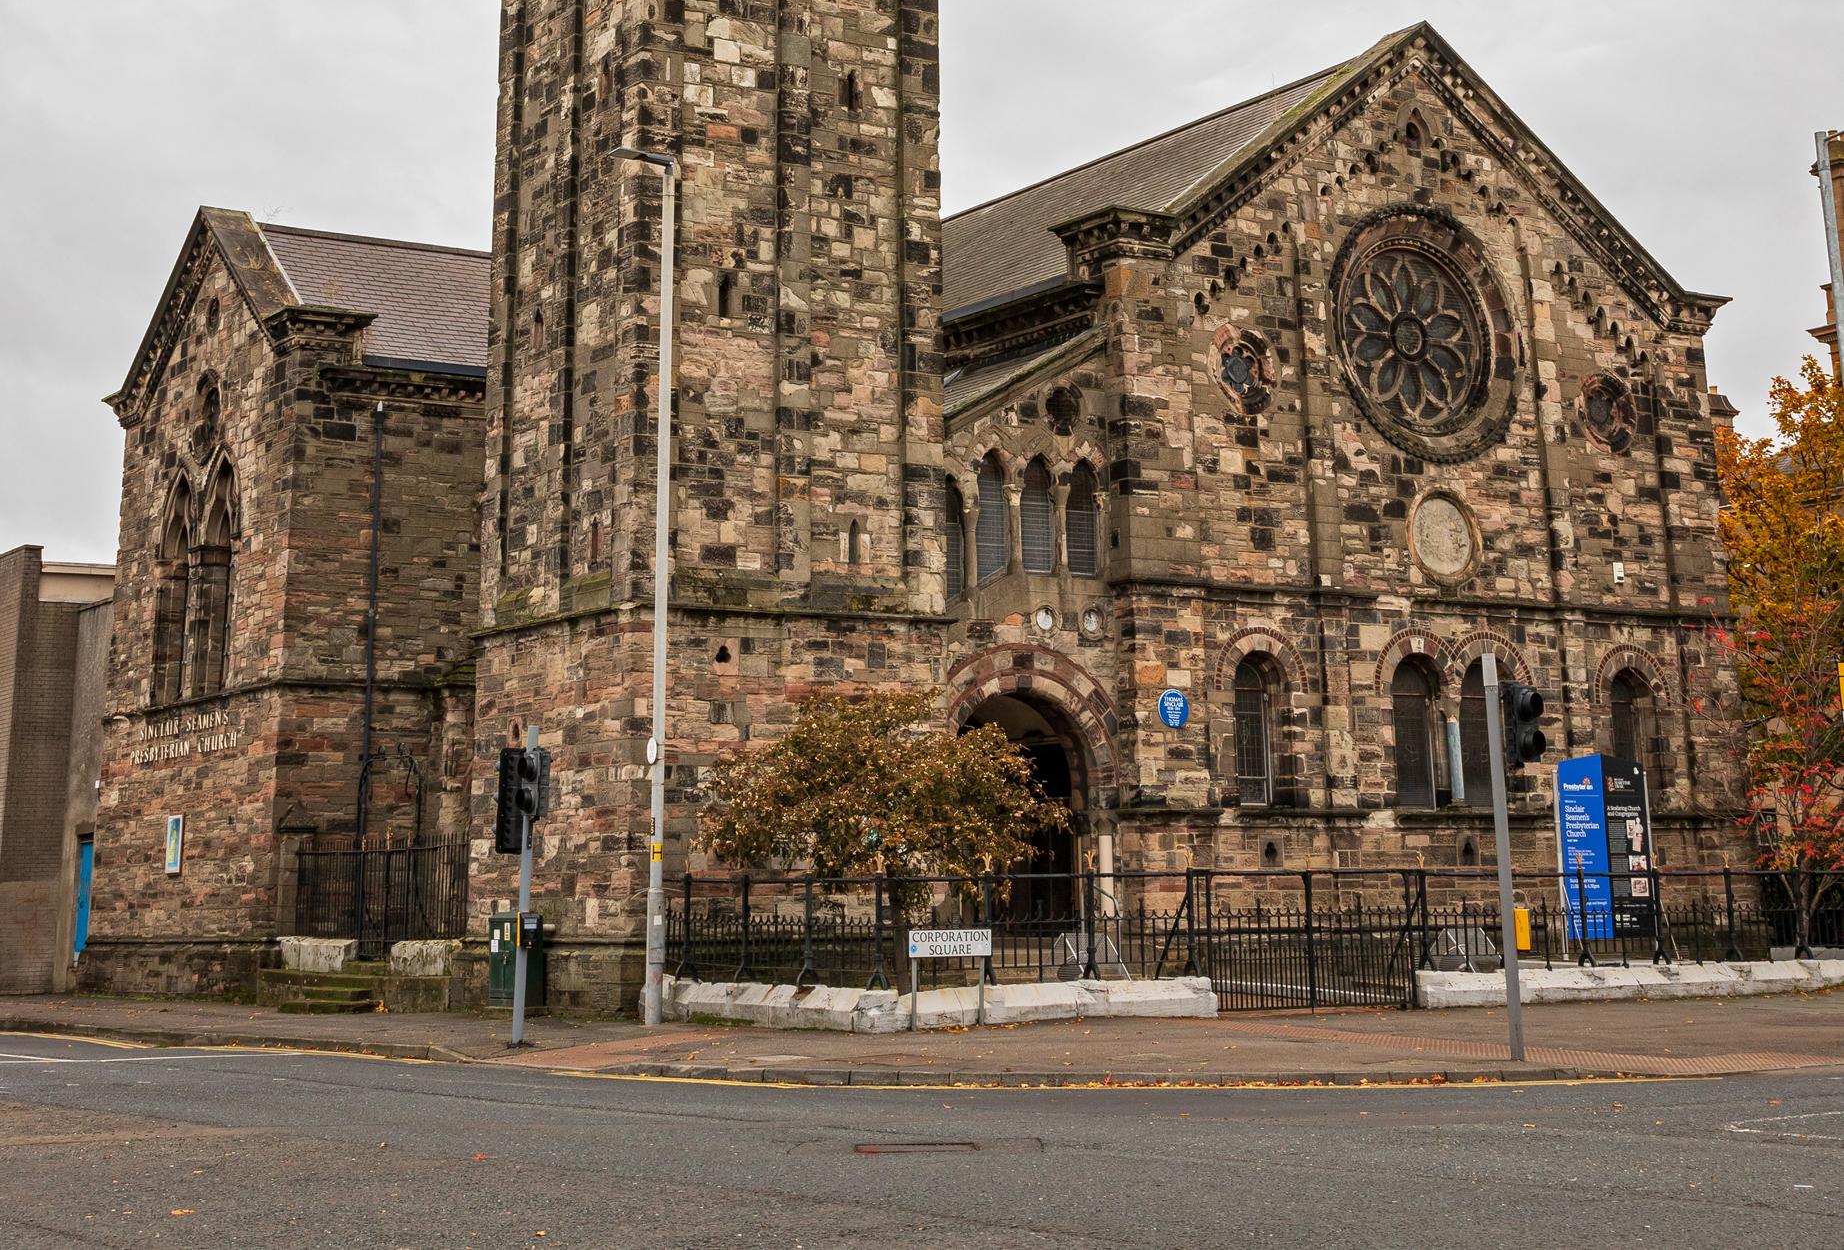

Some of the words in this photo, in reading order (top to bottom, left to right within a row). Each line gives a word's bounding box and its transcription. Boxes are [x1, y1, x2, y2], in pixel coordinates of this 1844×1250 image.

[140, 718, 179, 741] SINCLAIR
[130, 739, 190, 766] PRESBYTERIAN
[198, 731, 238, 753] CHURCH
[1565, 805, 1585, 813] Sinclair
[1566, 822, 1600, 830] Presbyterian
[1566, 829, 1587, 838] Church
[652, 845, 663, 860] H
[912, 931, 989, 943] CORPORATION
[929, 944, 972, 955] SQUARE
